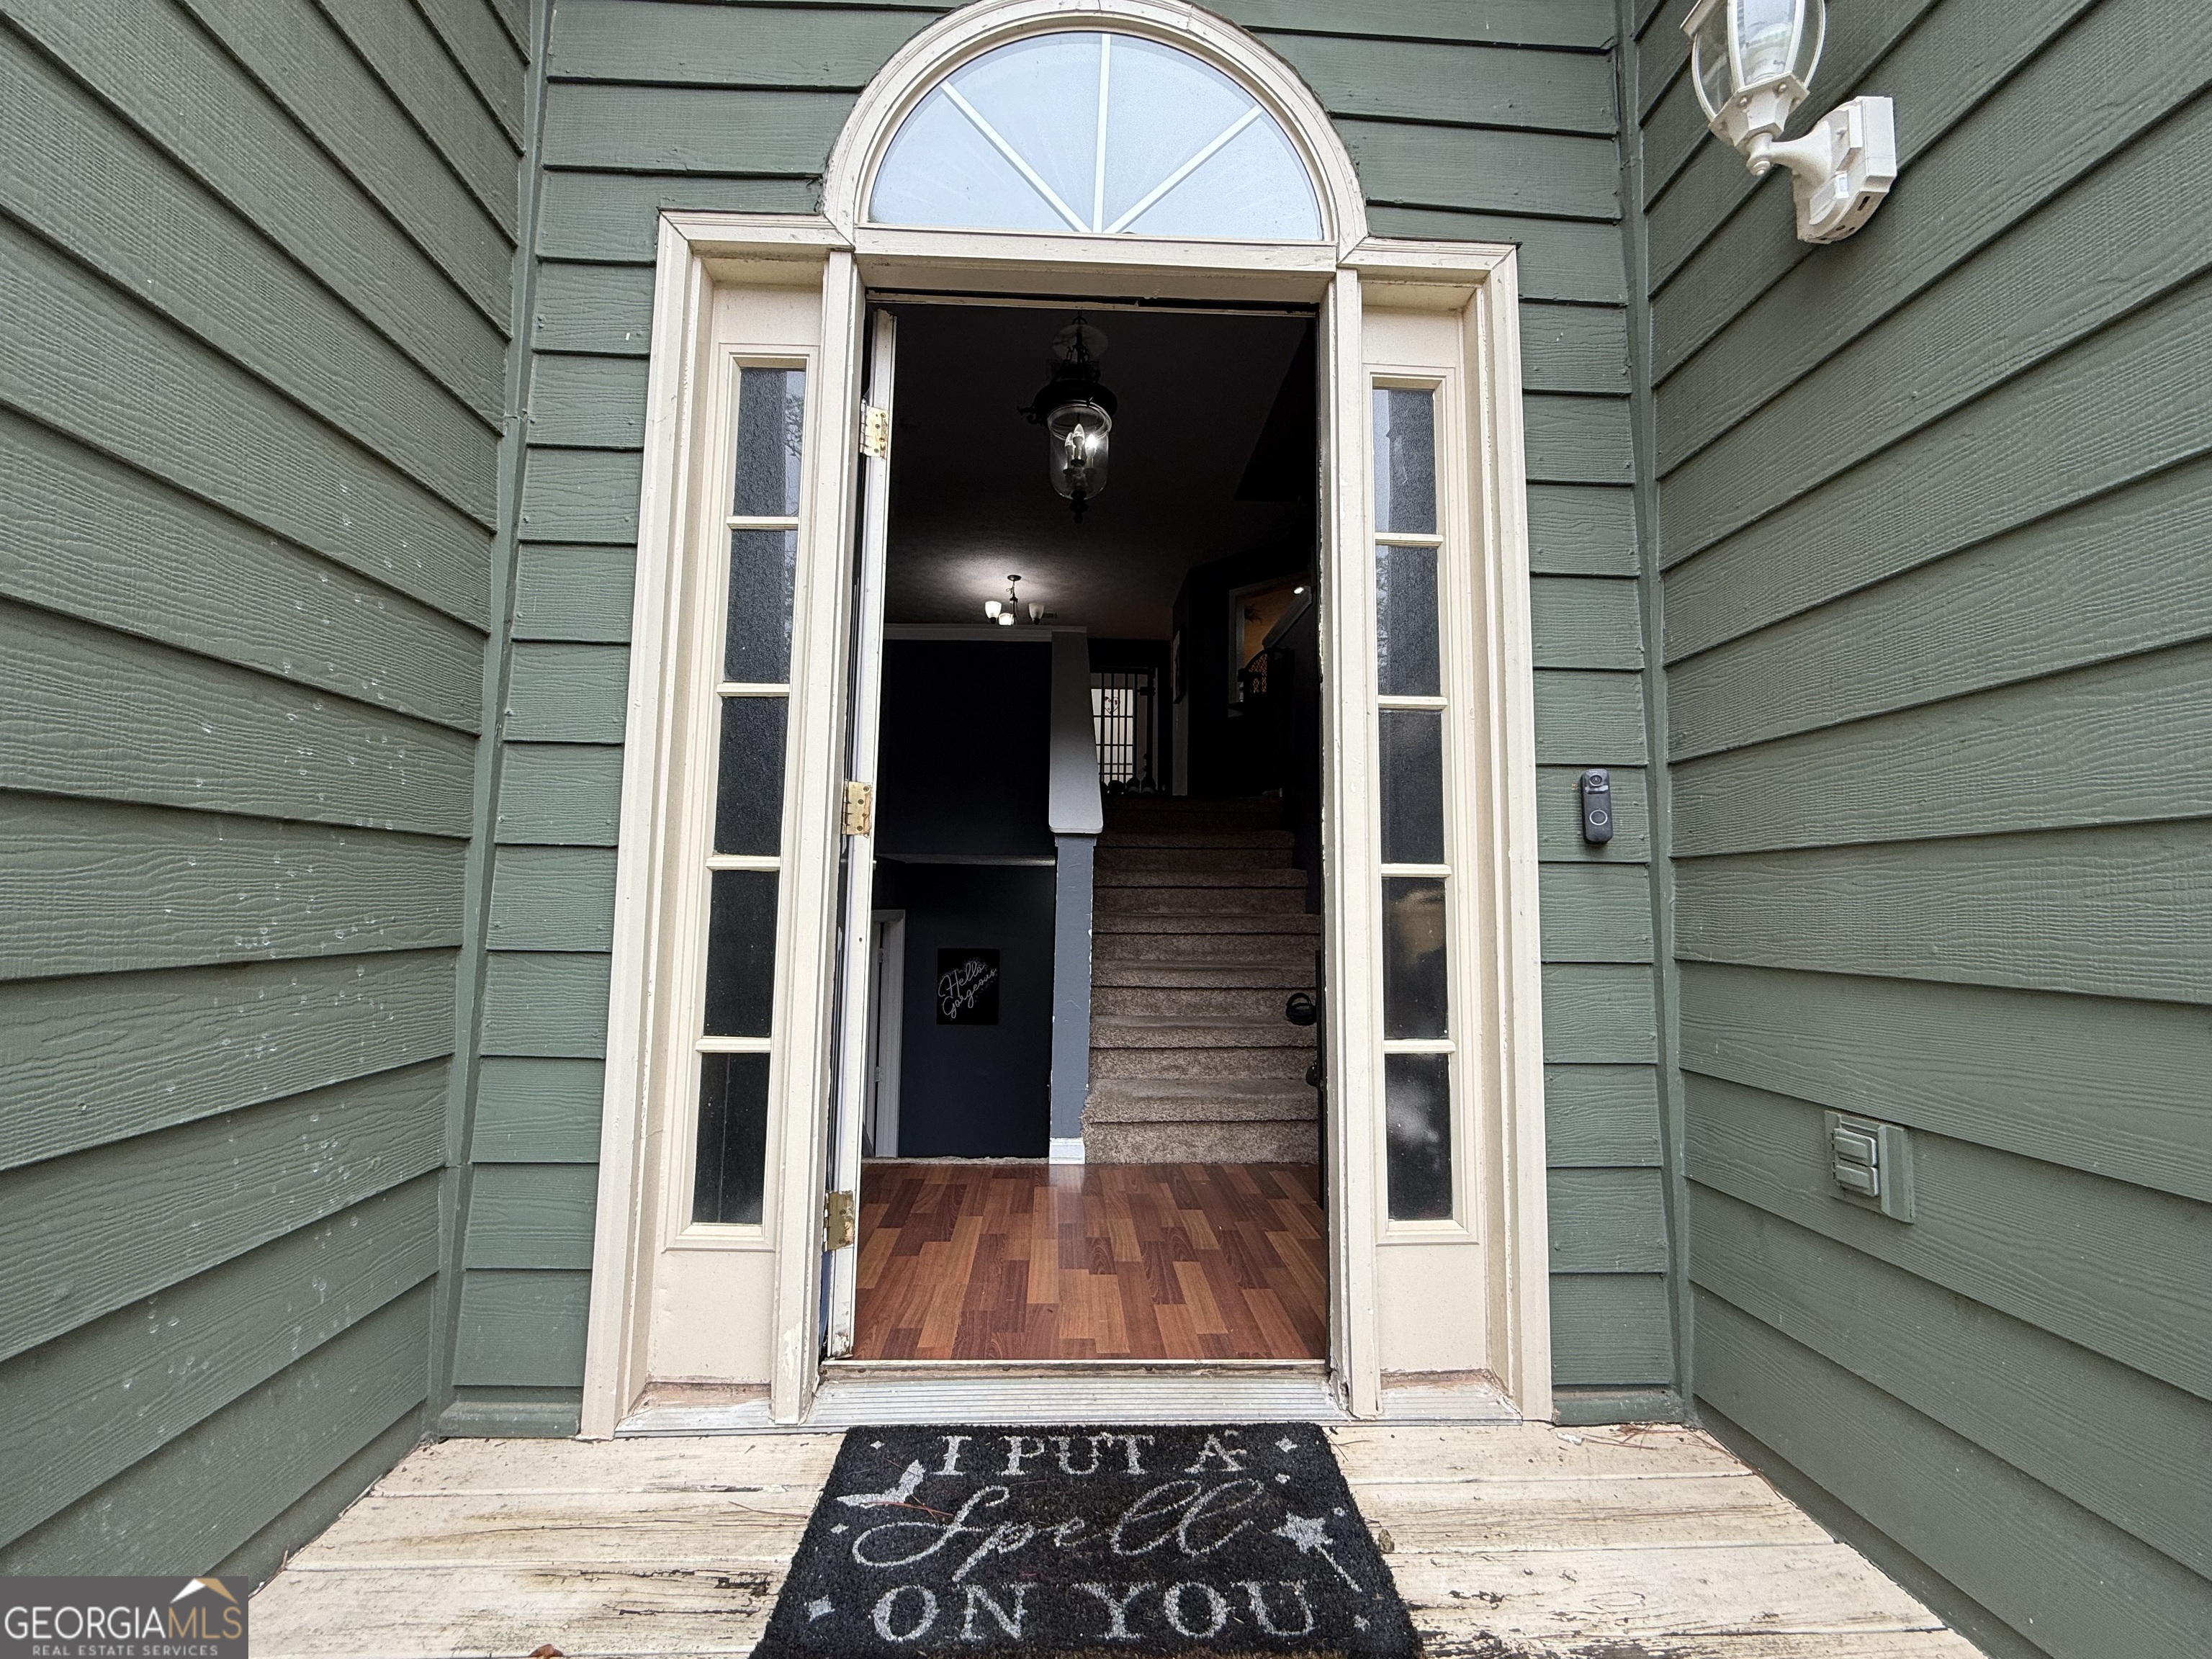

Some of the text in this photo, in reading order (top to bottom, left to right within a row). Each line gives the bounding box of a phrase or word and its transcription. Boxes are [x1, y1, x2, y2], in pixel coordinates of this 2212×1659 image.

[938, 961, 985, 997] Hello
[943, 968, 997, 1019] Gorgeous
[935, 1433, 1245, 1475] I PUT A
[853, 1478, 1263, 1581] Spell
[871, 1580, 1315, 1642] ON YOU
